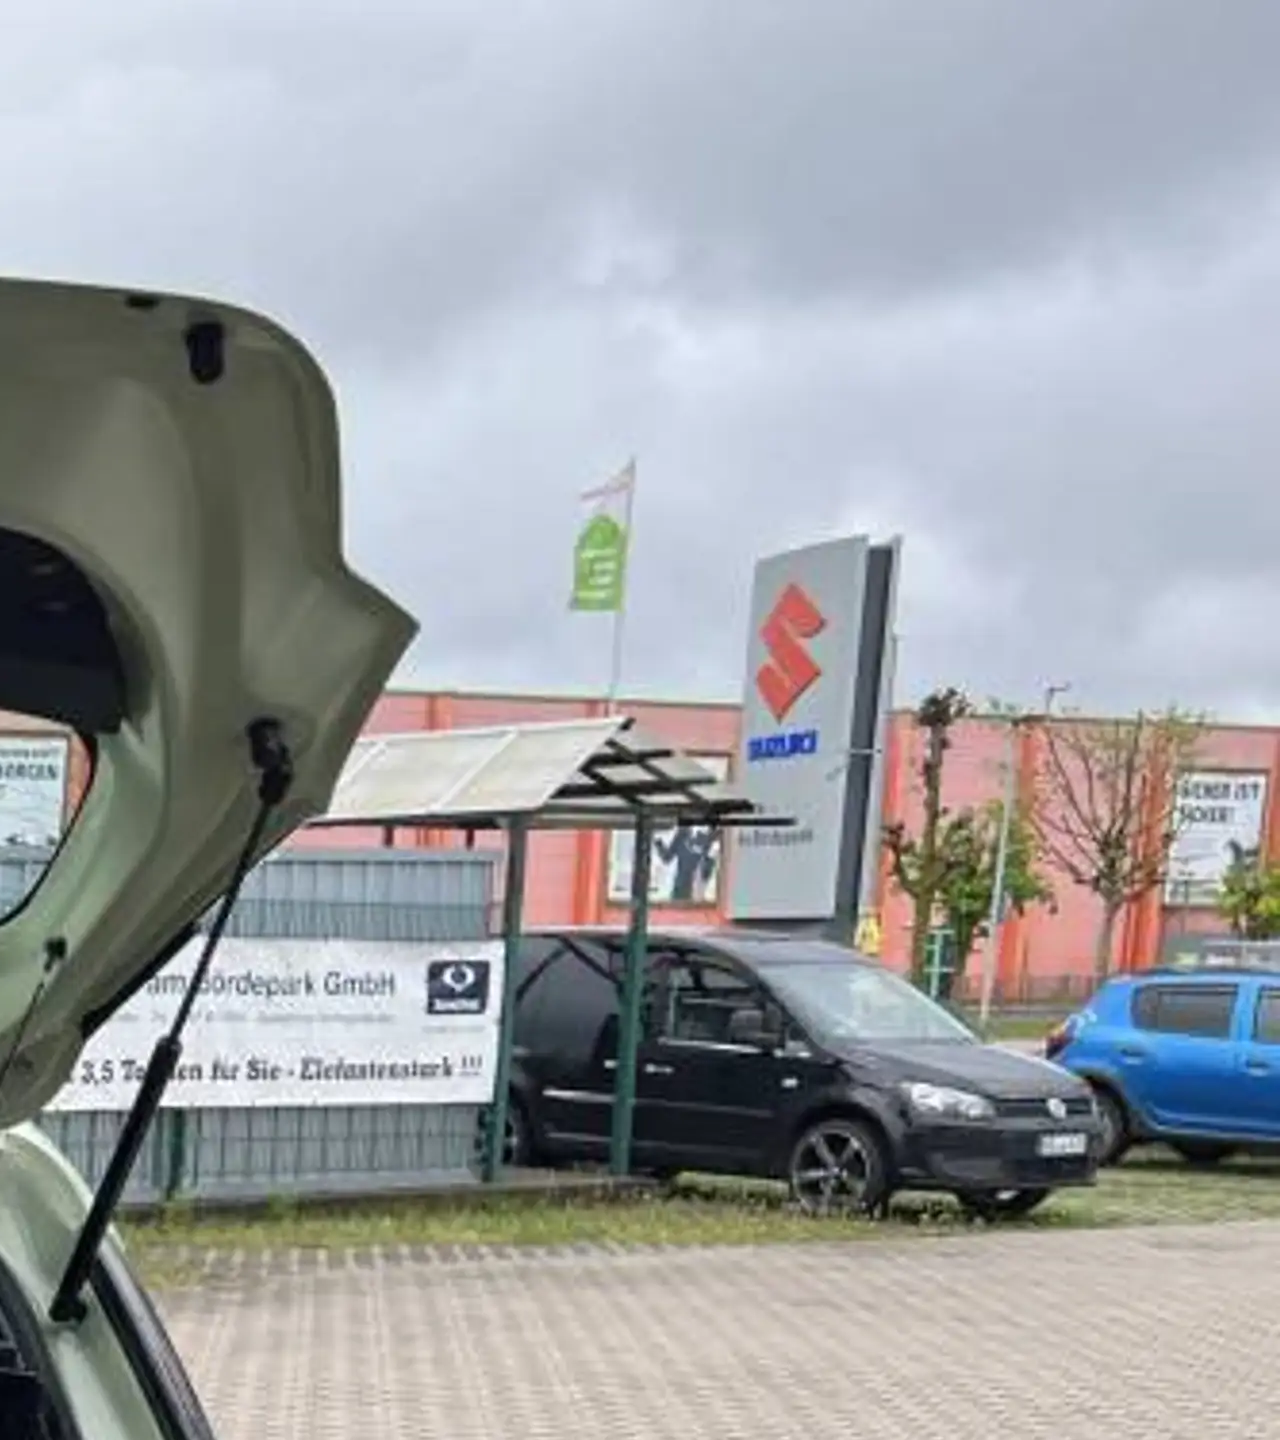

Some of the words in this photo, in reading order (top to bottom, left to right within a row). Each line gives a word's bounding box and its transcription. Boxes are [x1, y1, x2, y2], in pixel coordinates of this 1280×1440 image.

[323, 970, 395, 996] GmbH
[81, 1060, 114, 1084] 3,5
[246, 1059, 282, 1081] Sie
